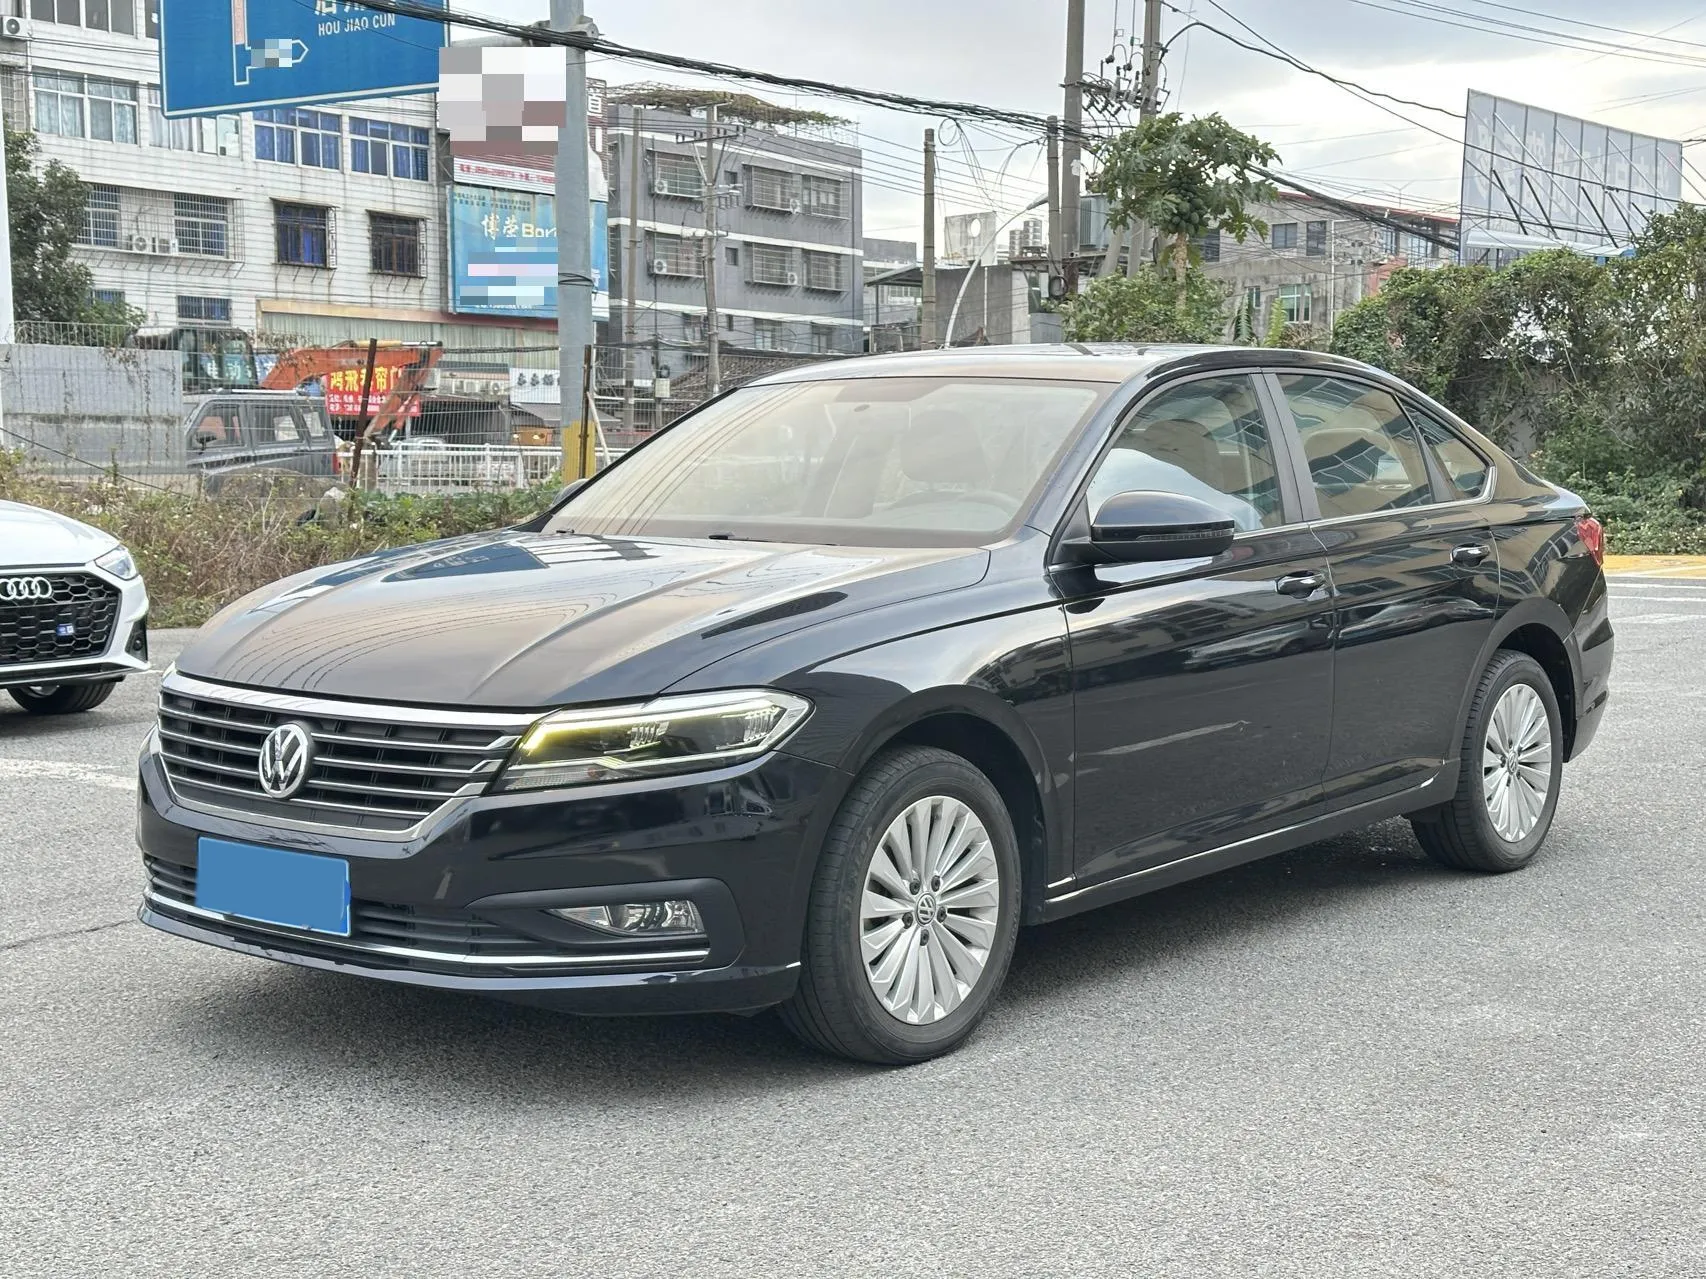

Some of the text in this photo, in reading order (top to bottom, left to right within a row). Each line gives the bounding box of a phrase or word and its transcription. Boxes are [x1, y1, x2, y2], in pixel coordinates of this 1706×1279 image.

[318, 12, 396, 37] HOU JIAO CUN
